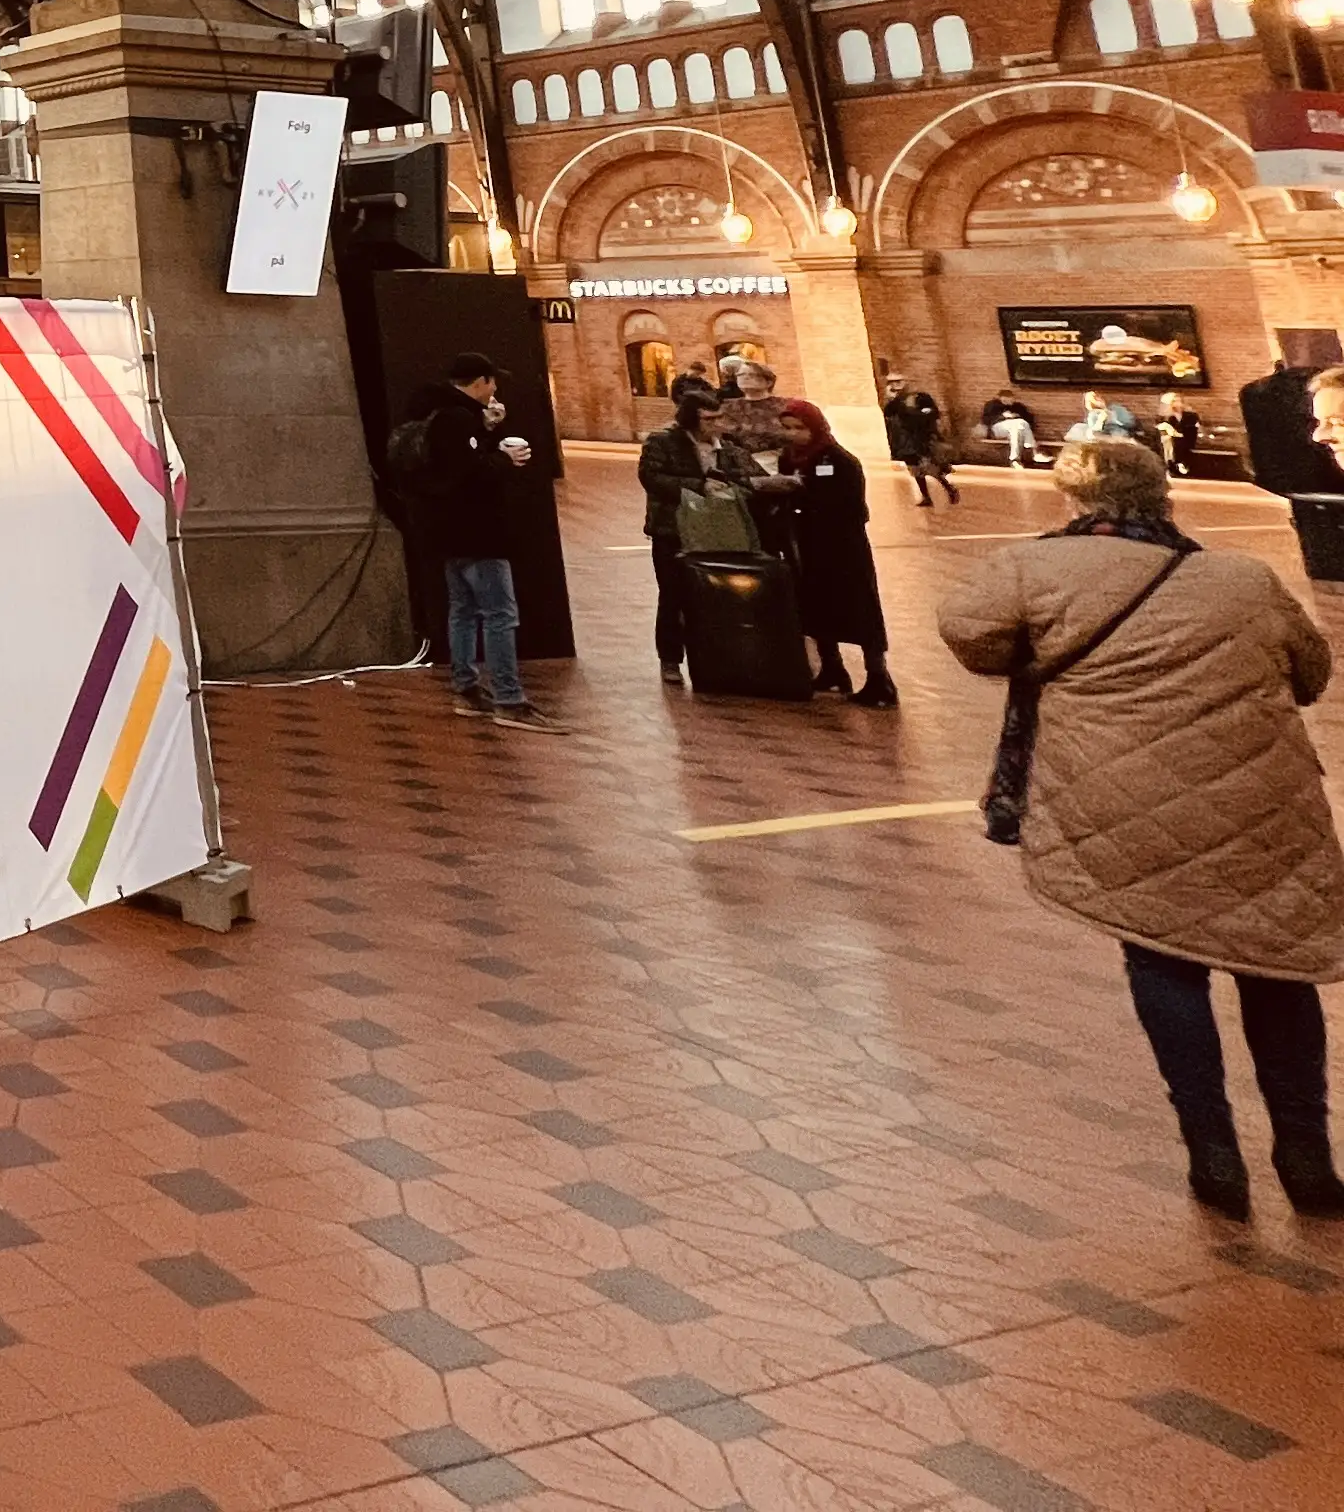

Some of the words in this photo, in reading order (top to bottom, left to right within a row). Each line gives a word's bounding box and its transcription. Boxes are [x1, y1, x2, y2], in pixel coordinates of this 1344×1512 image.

[287, 120, 311, 134] Følg
[270, 254, 285, 267] på
[569, 278, 695, 298] STARBUCKS
[697, 276, 788, 295] COFFEE
